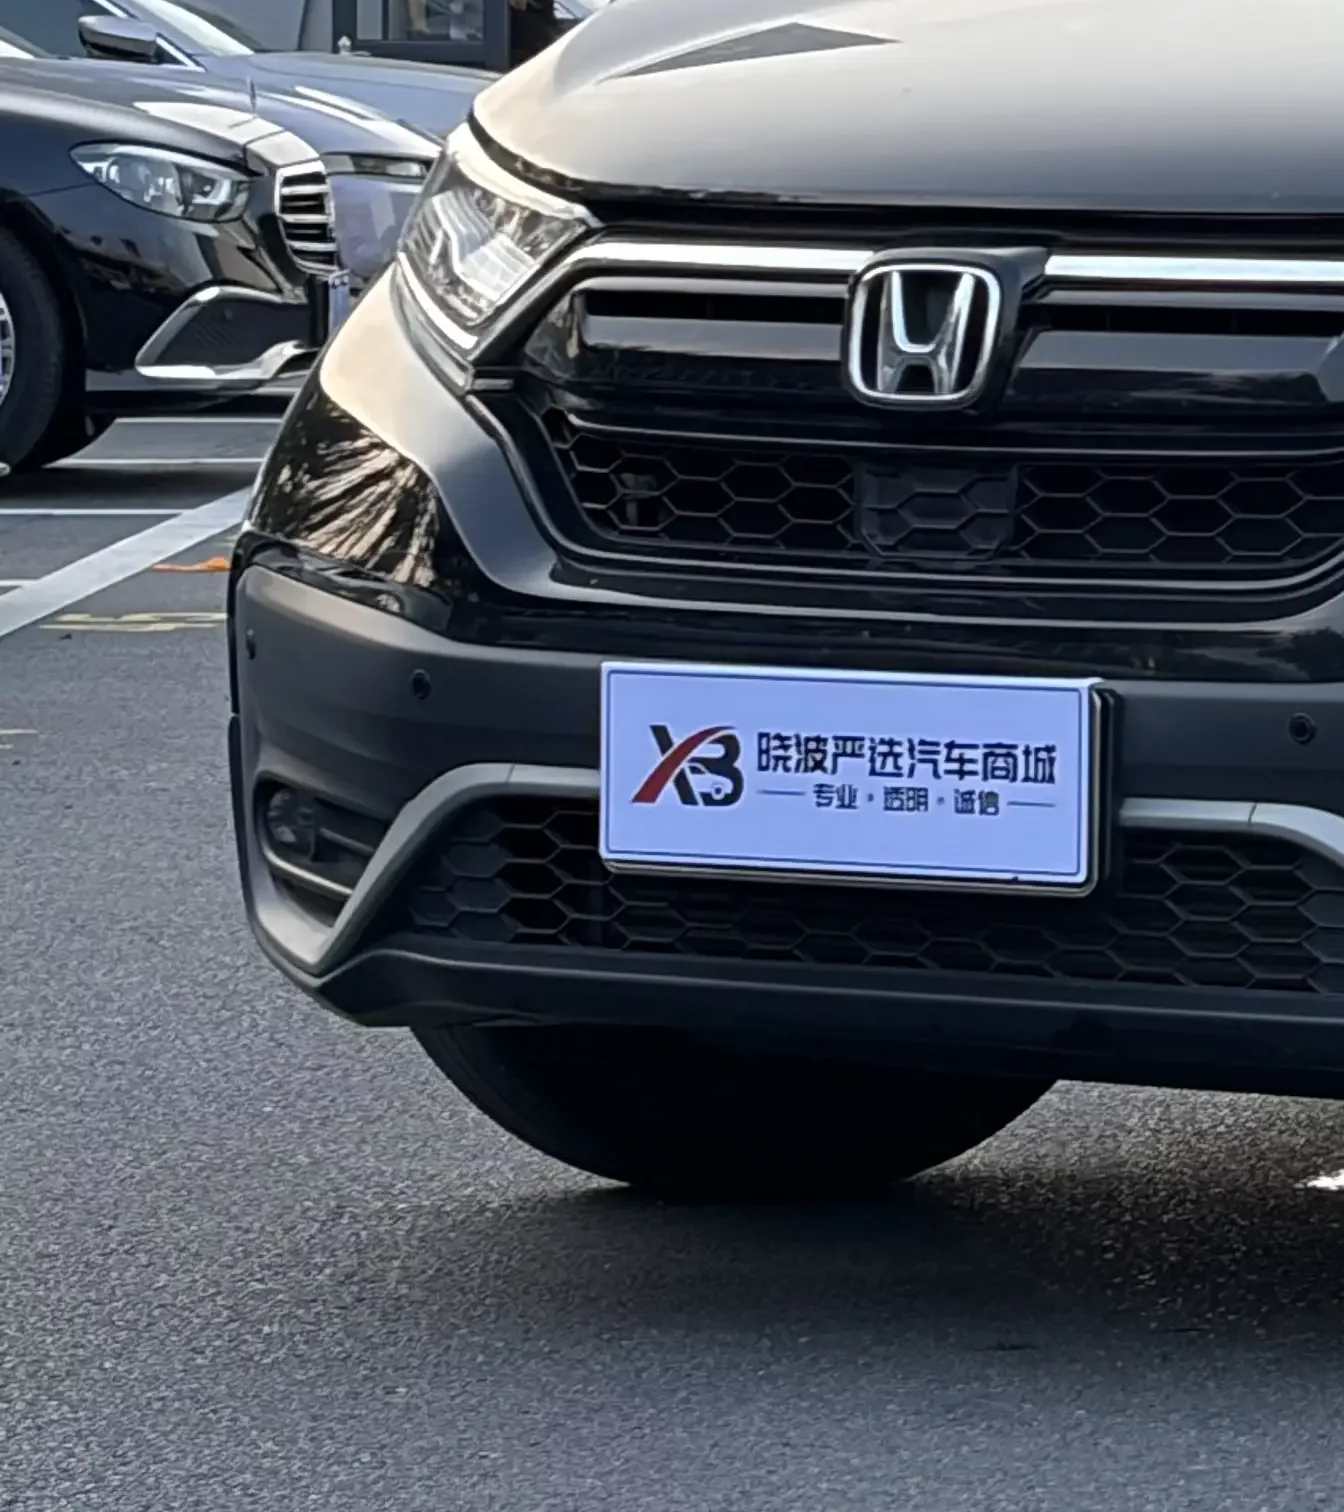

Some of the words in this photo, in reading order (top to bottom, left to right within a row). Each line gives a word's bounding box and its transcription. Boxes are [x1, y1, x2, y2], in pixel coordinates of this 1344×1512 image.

[756, 731, 1057, 785] 晓波严选汽车商城
